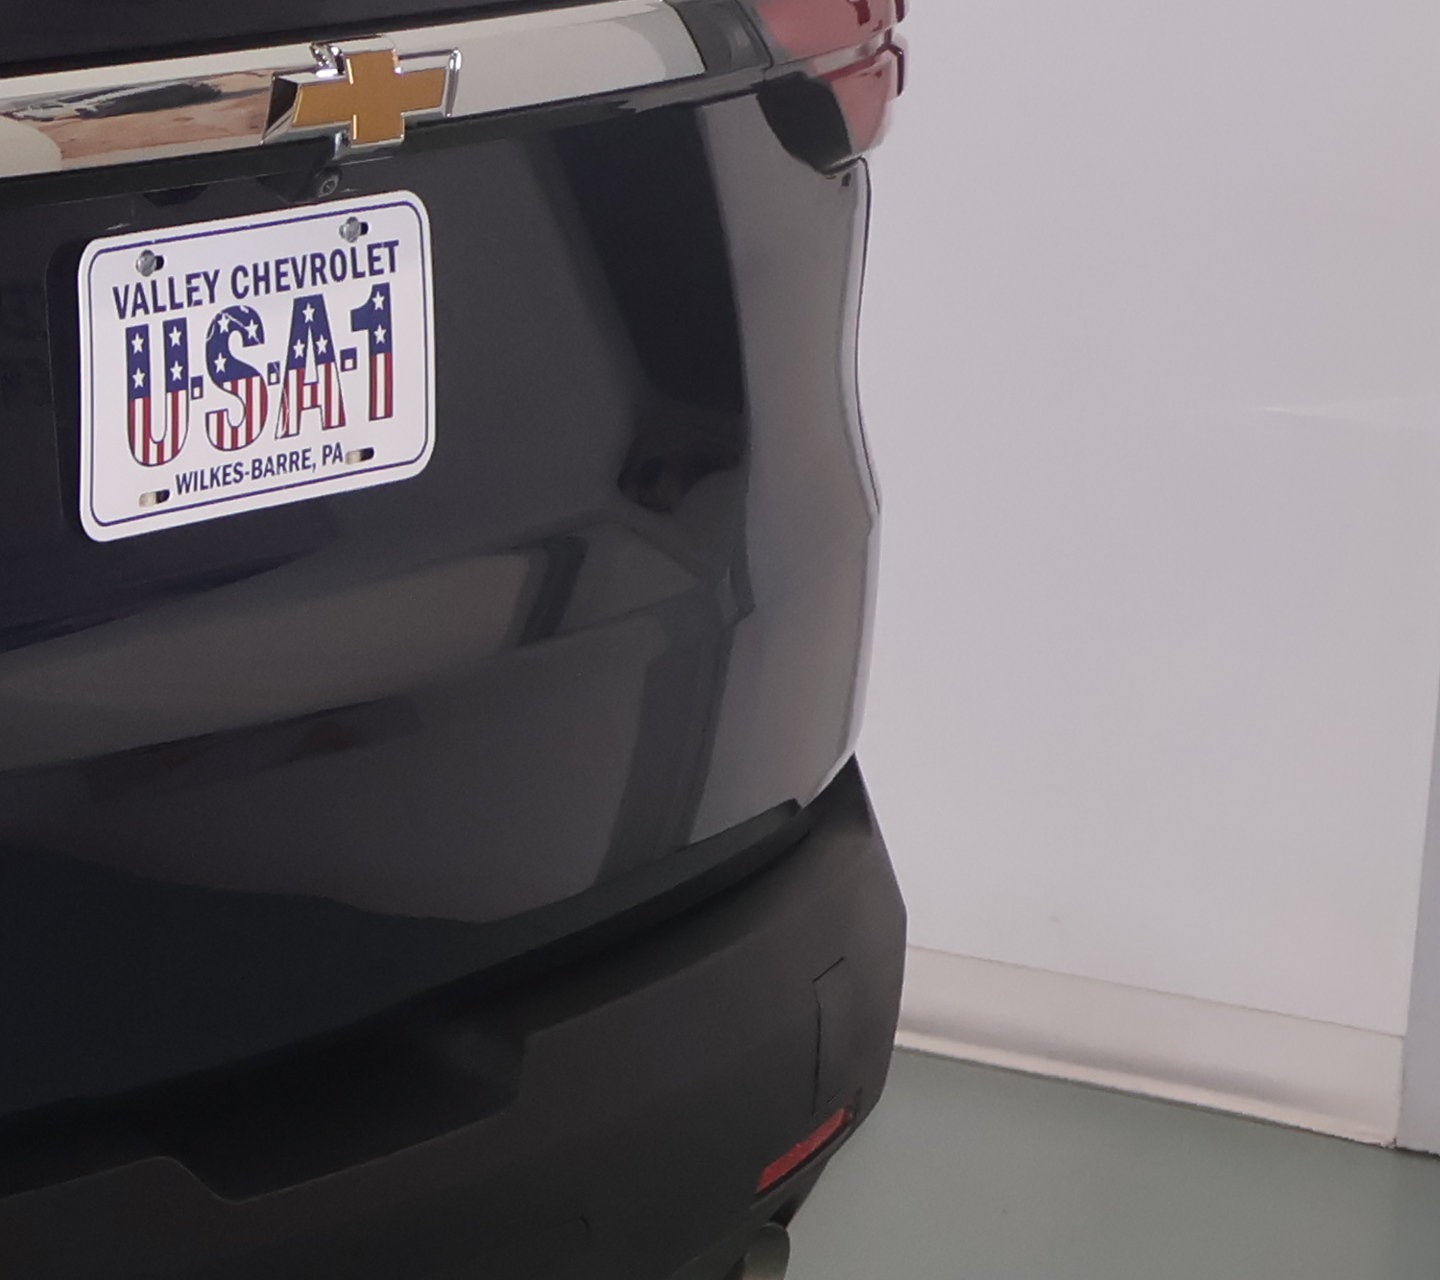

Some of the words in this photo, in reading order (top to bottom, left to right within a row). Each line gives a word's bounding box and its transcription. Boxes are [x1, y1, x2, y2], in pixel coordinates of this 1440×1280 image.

[112, 269, 221, 320] VALLEY
[230, 239, 400, 301] CHEVROLET
[321, 442, 344, 467] PA
